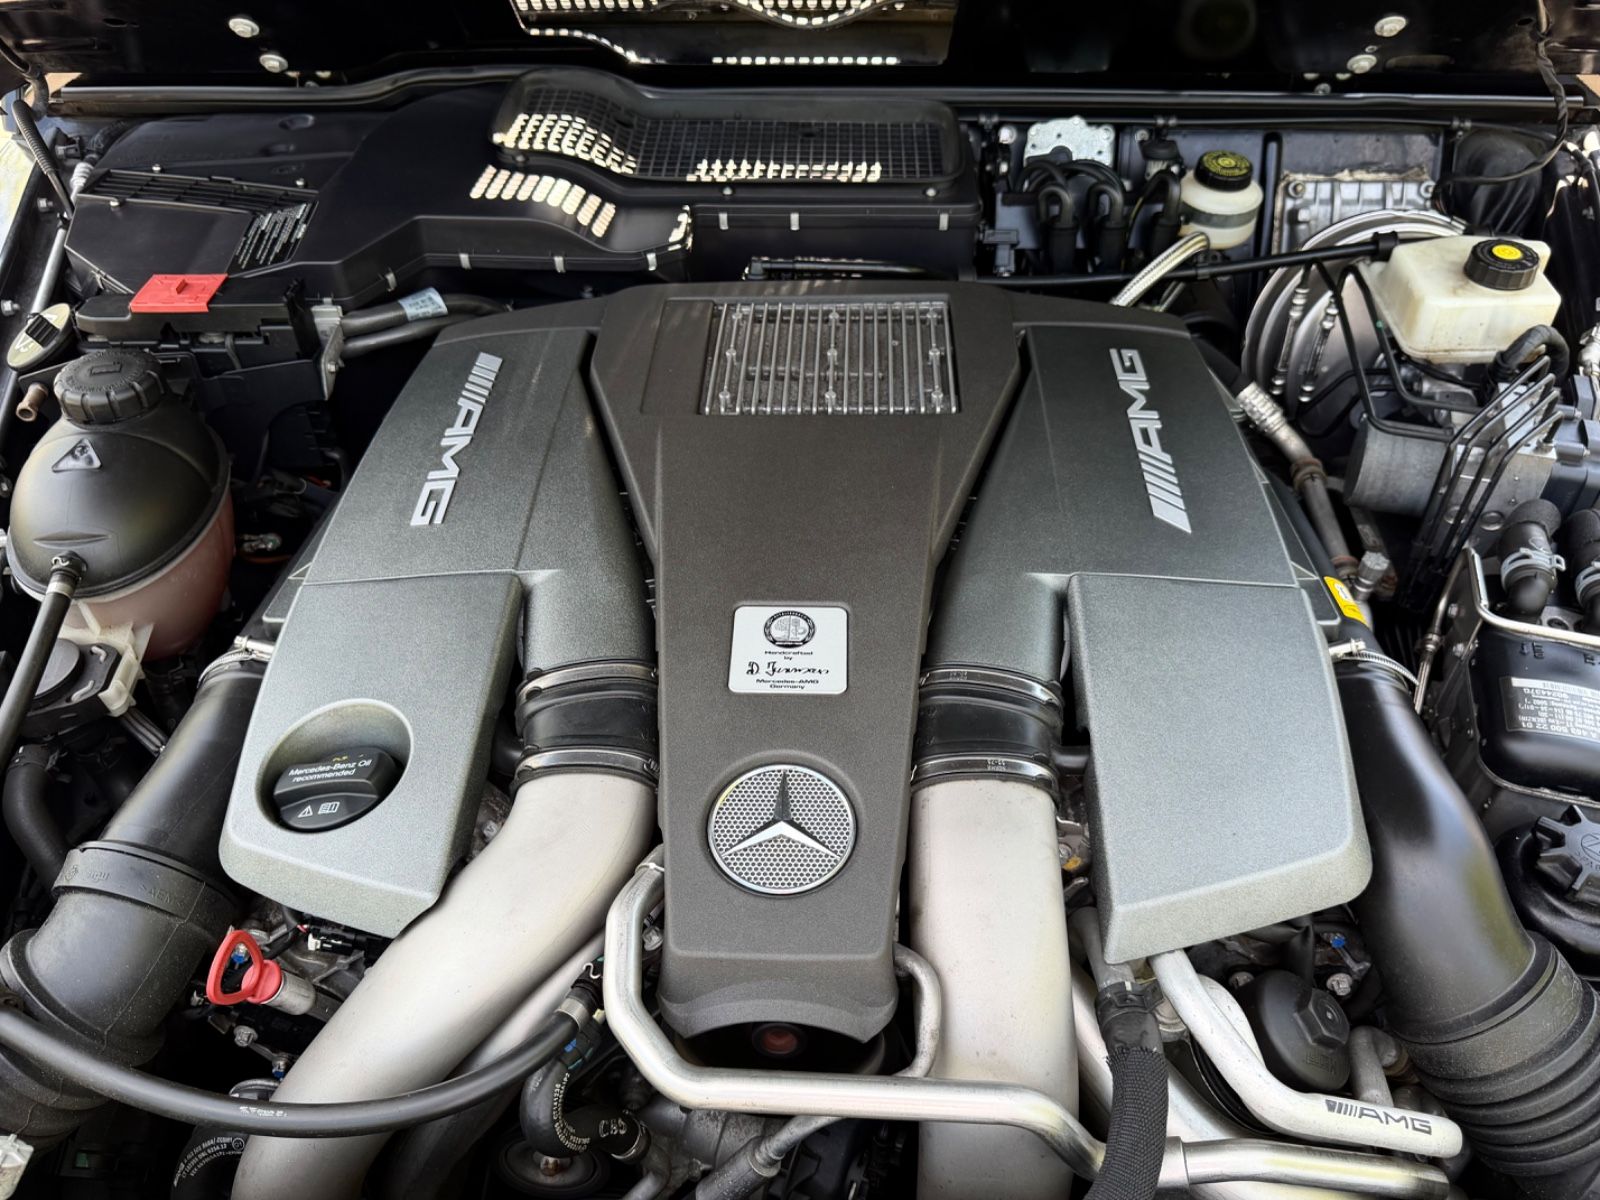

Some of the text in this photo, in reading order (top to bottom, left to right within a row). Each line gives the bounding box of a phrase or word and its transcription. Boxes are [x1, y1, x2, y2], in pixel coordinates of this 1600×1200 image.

[1108, 348, 1174, 467] AMG
[410, 396, 484, 527] AMG
[288, 759, 373, 776] Mercedes-Benz Oil
[292, 768, 356, 783] recommended
[1358, 1105, 1433, 1136] AMG
